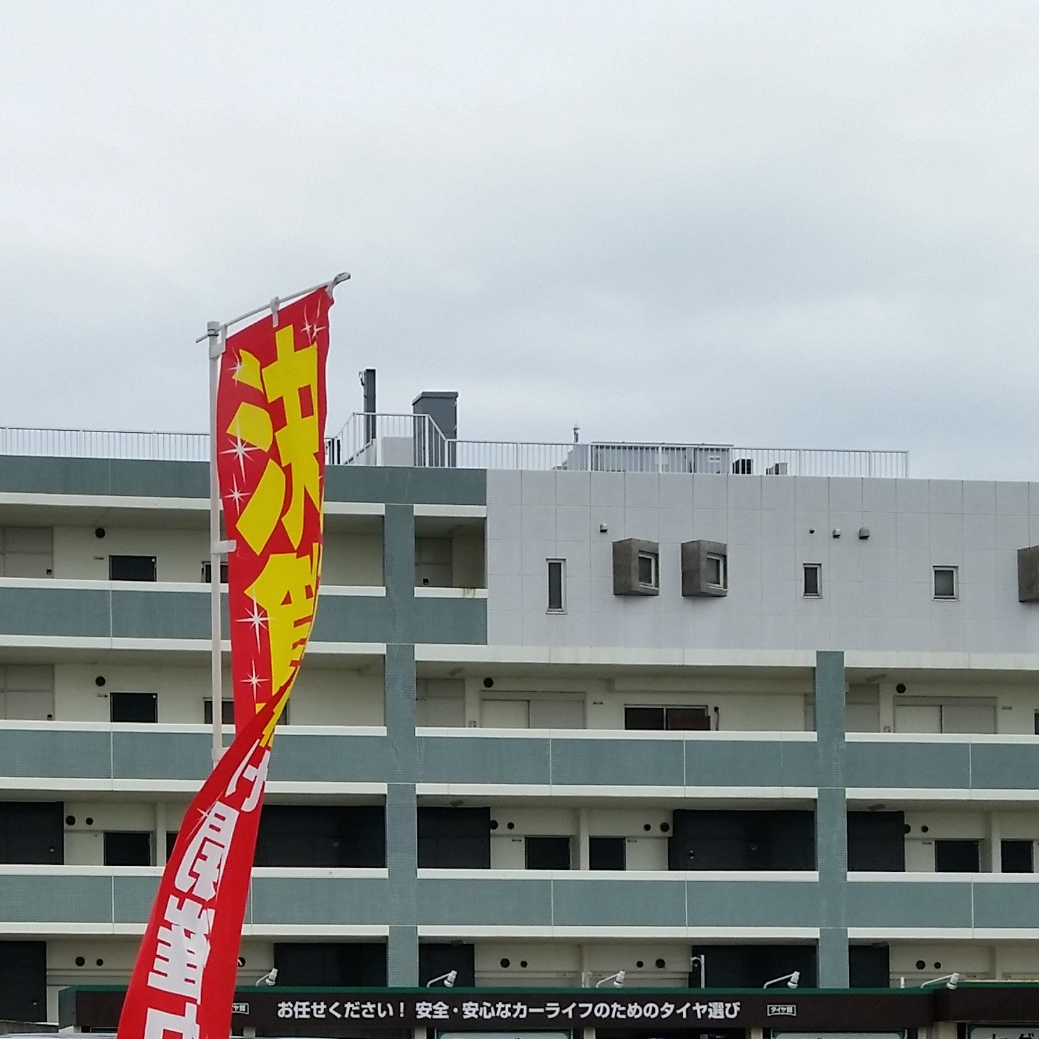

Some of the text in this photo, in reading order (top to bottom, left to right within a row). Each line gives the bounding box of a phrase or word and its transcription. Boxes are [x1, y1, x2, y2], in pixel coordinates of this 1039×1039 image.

[415, 1001, 741, 1020] 安全・安心なカーライフのためのタイヤ選び
